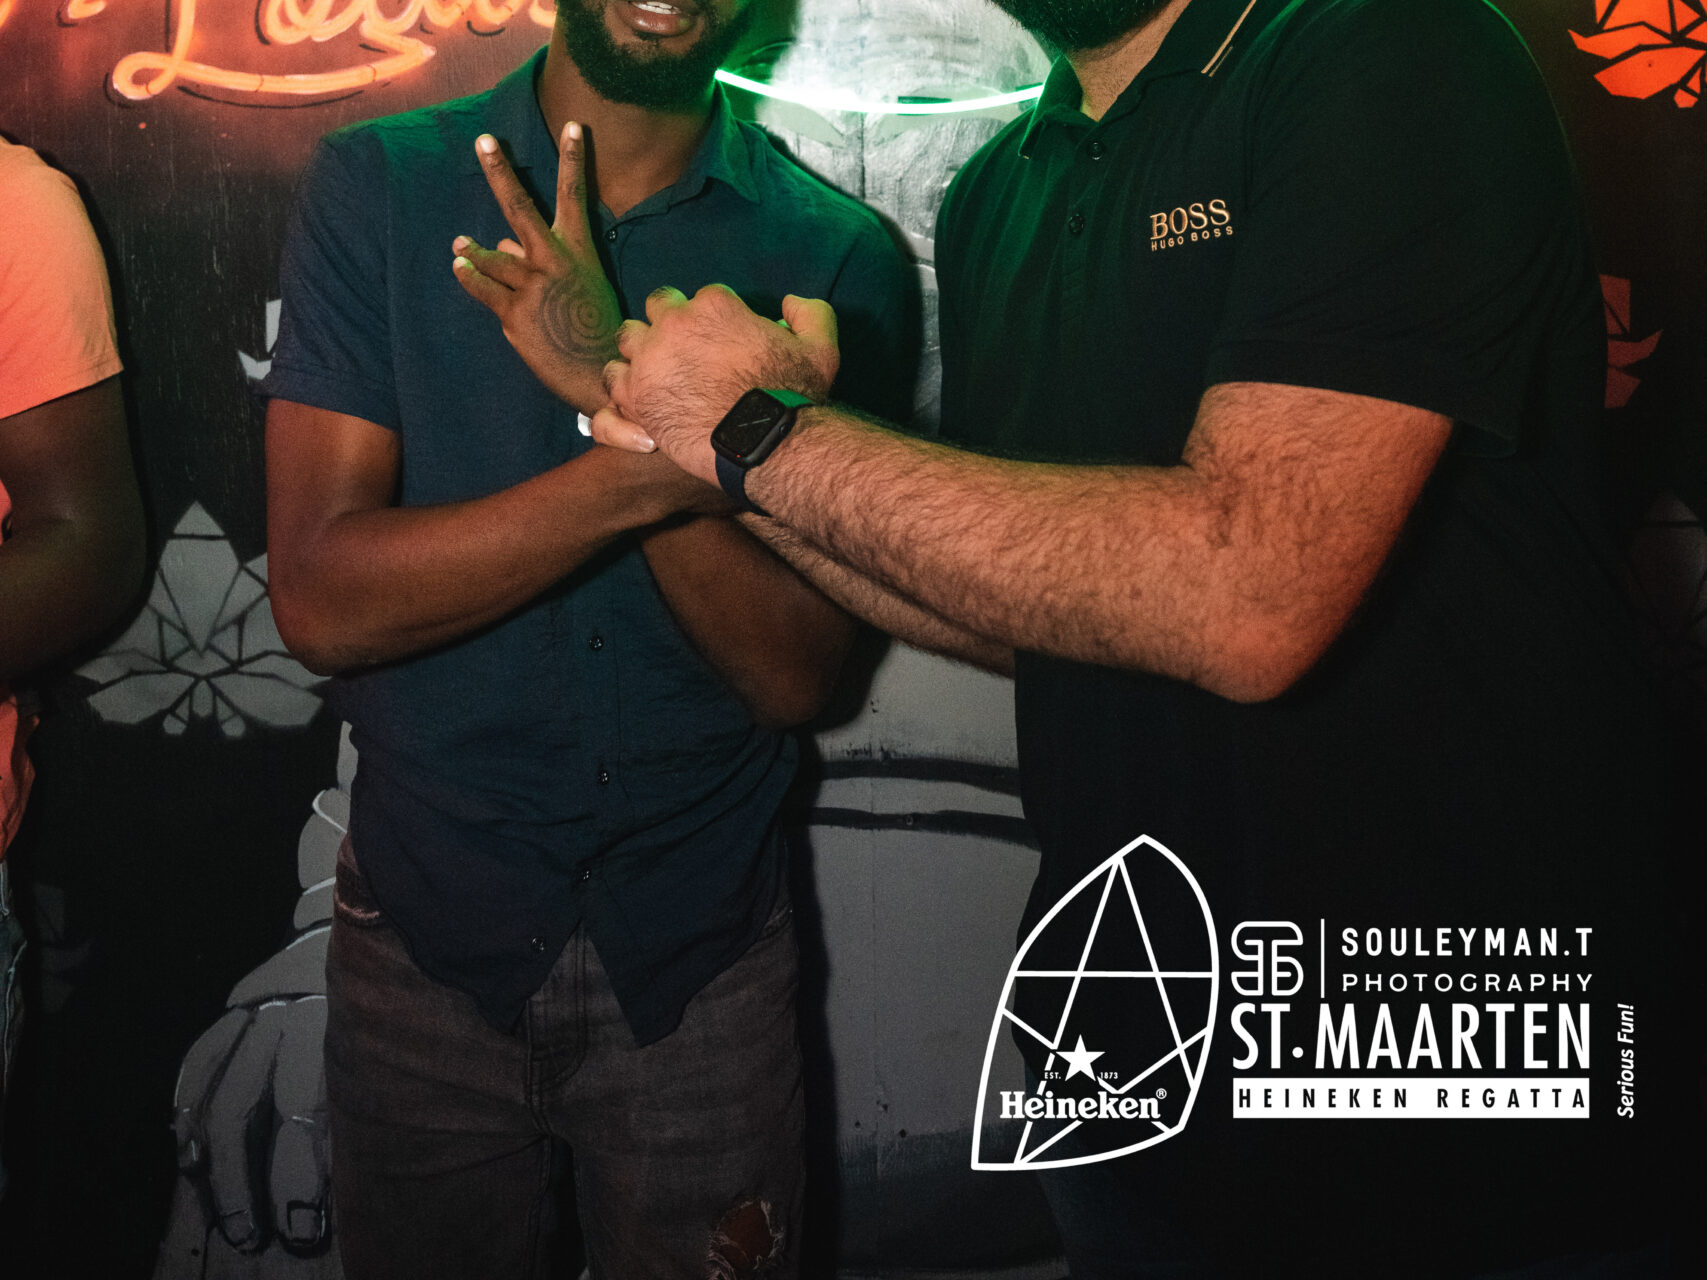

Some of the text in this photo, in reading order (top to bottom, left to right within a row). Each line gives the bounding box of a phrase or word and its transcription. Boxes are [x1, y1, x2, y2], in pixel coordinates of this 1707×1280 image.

[1149, 198, 1231, 240] BOSS
[1151, 225, 1234, 252] HUGO BOSS
